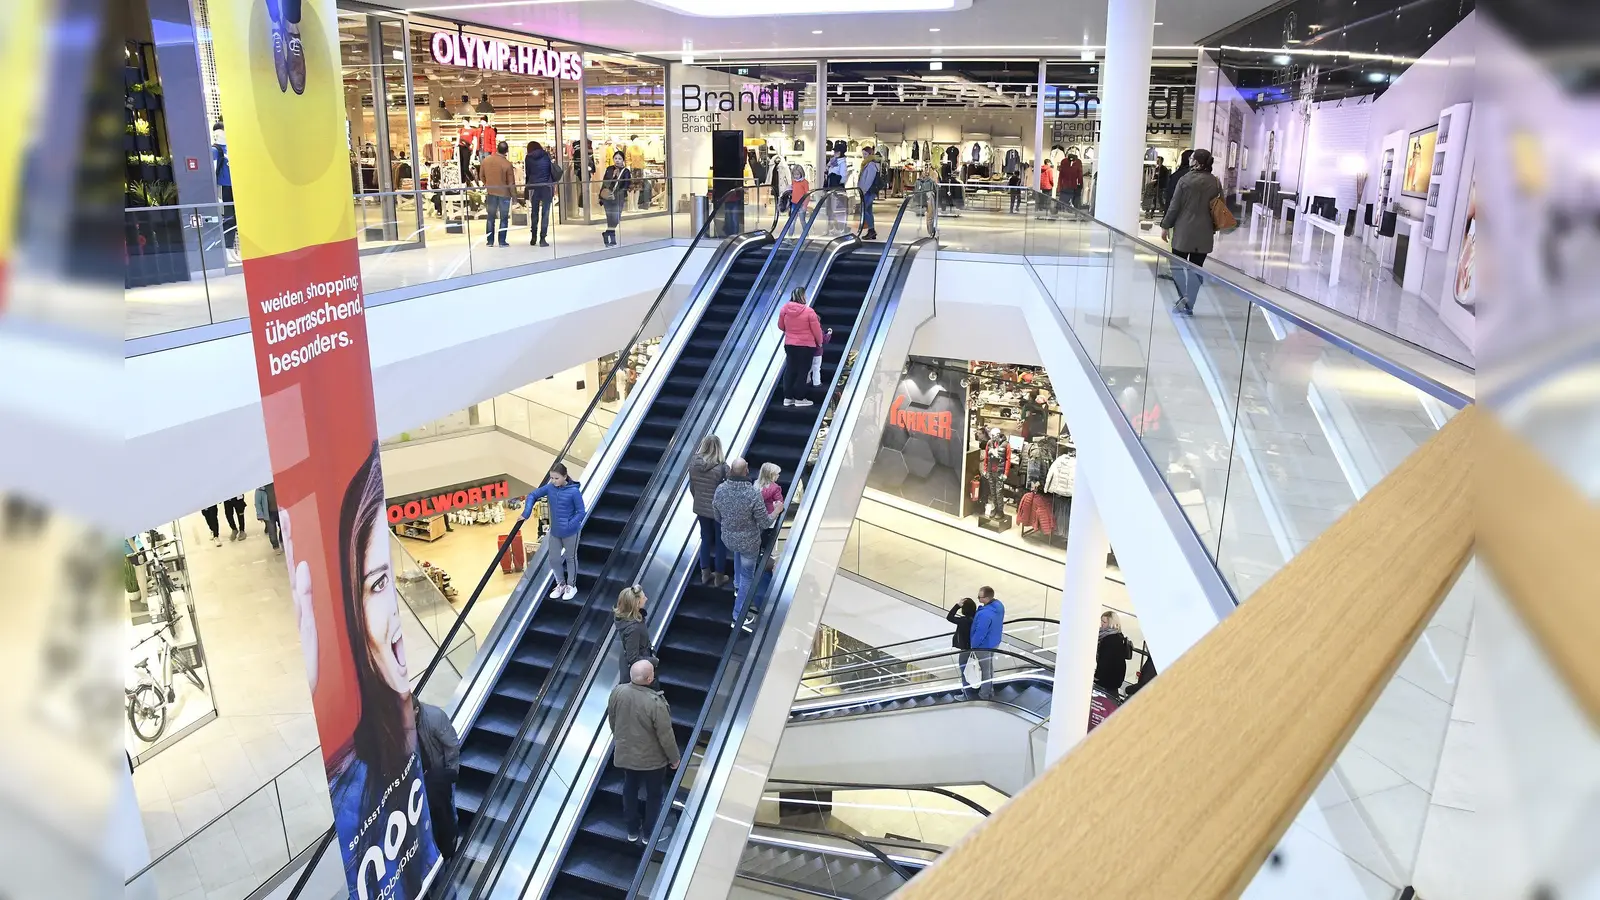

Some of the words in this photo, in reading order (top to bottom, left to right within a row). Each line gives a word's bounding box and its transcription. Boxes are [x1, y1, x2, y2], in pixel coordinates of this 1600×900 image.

[681, 112, 722, 123] BrandIT
[747, 114, 799, 125] OUTLET
[681, 123, 722, 133] BrandIT
[1147, 122, 1193, 135] UTLE
[264, 294, 363, 345] überraschend,
[268, 331, 354, 376] besonders.
[889, 394, 953, 440] YORKER
[386, 480, 509, 524] OOLWORTH
[348, 835, 360, 851] SO
